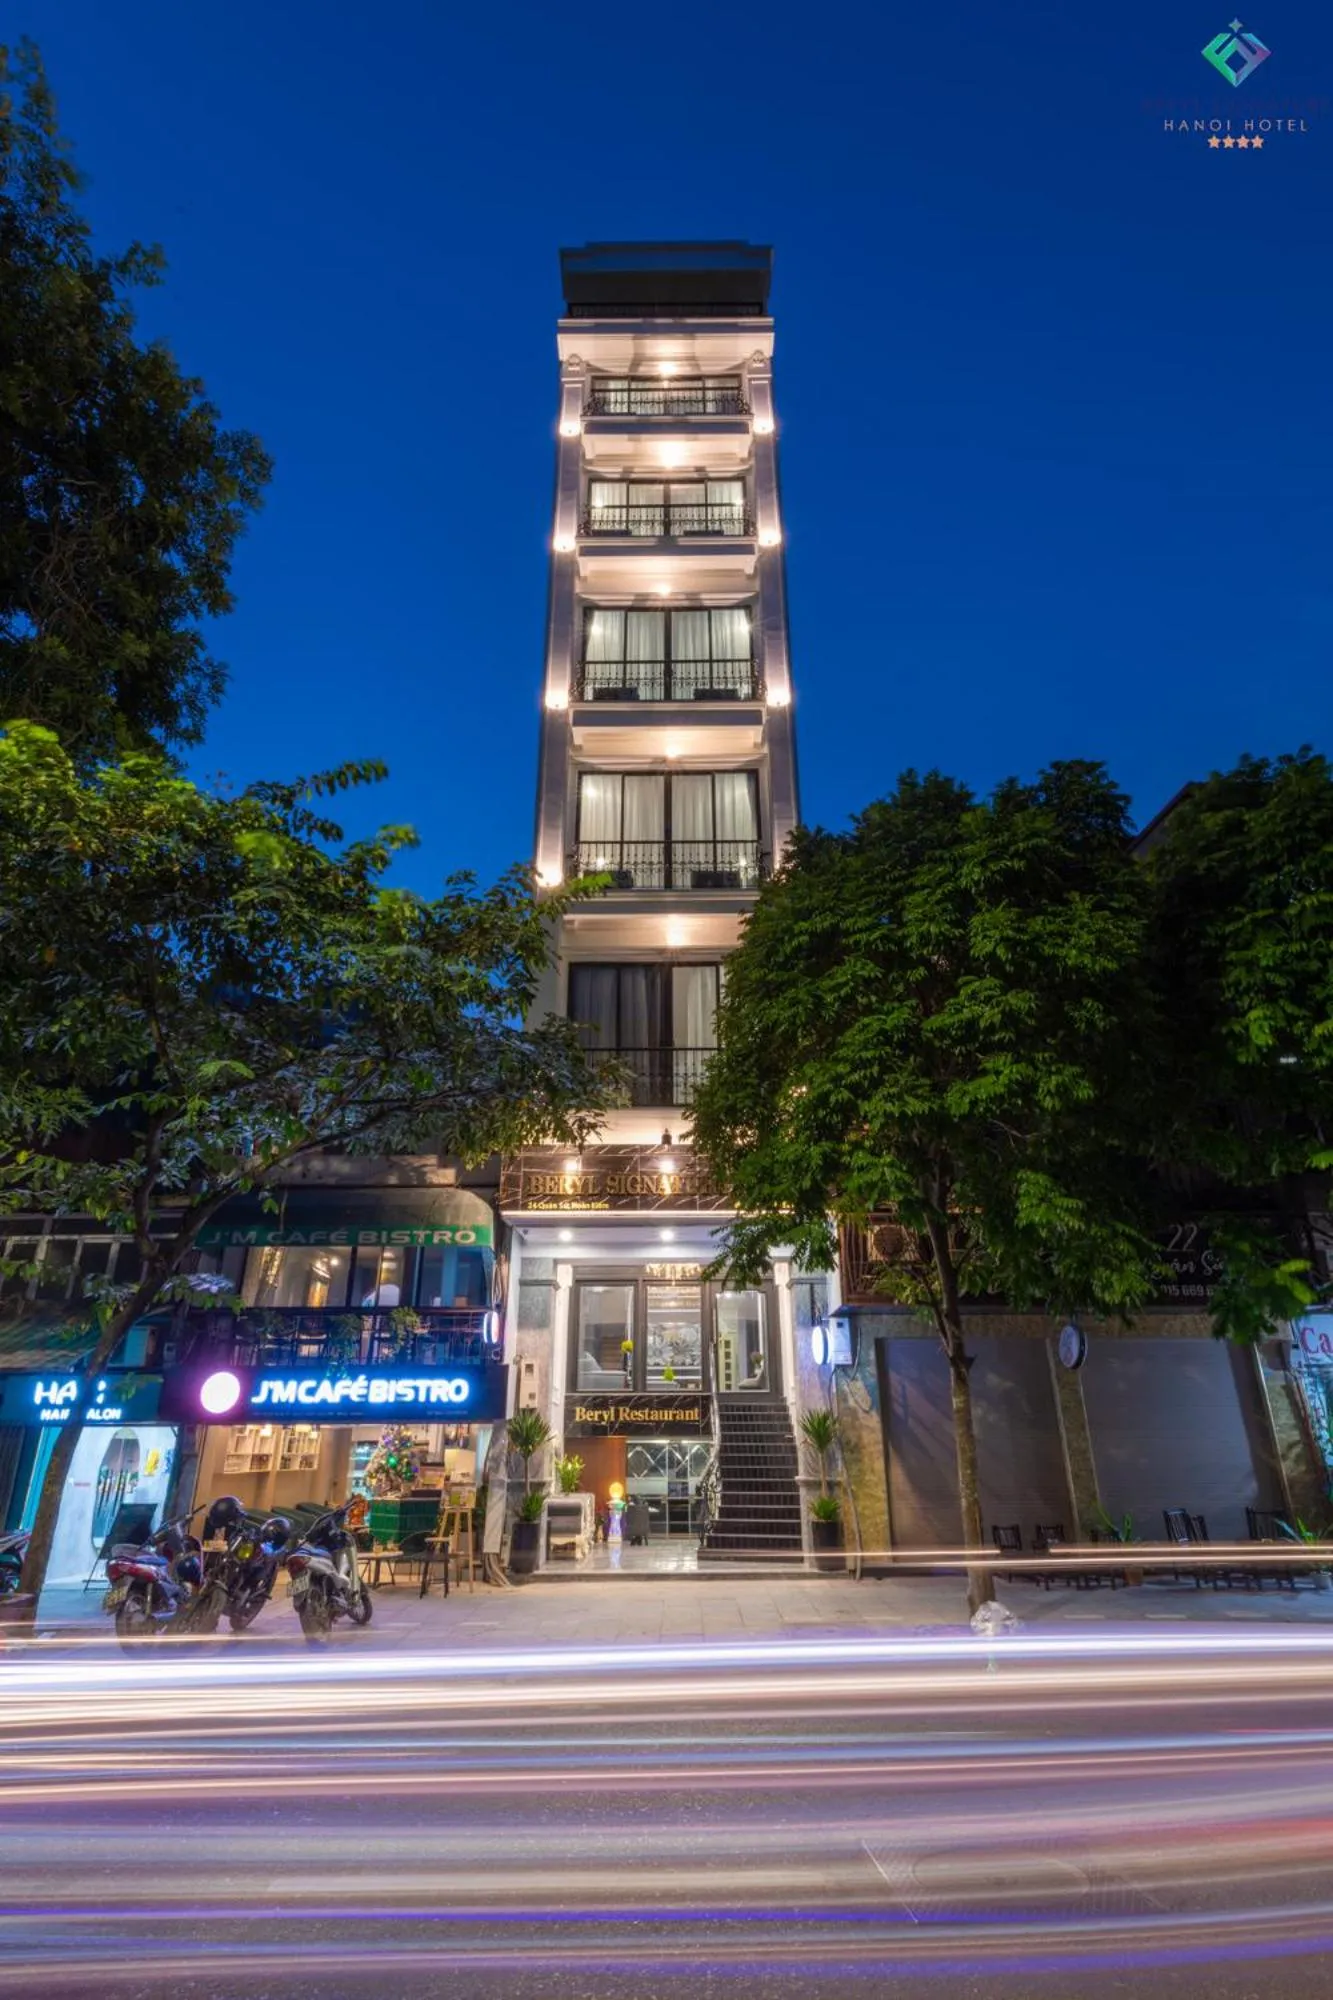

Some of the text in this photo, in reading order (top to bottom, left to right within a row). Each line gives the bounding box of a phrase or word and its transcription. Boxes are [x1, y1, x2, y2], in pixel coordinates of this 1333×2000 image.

[528, 1175, 598, 1194] BERYL
[205, 1227, 477, 1244] J'M CAFÉ BISTRO
[1166, 1223, 1198, 1251] 22
[575, 1406, 700, 1424] Beryl Restaurant
